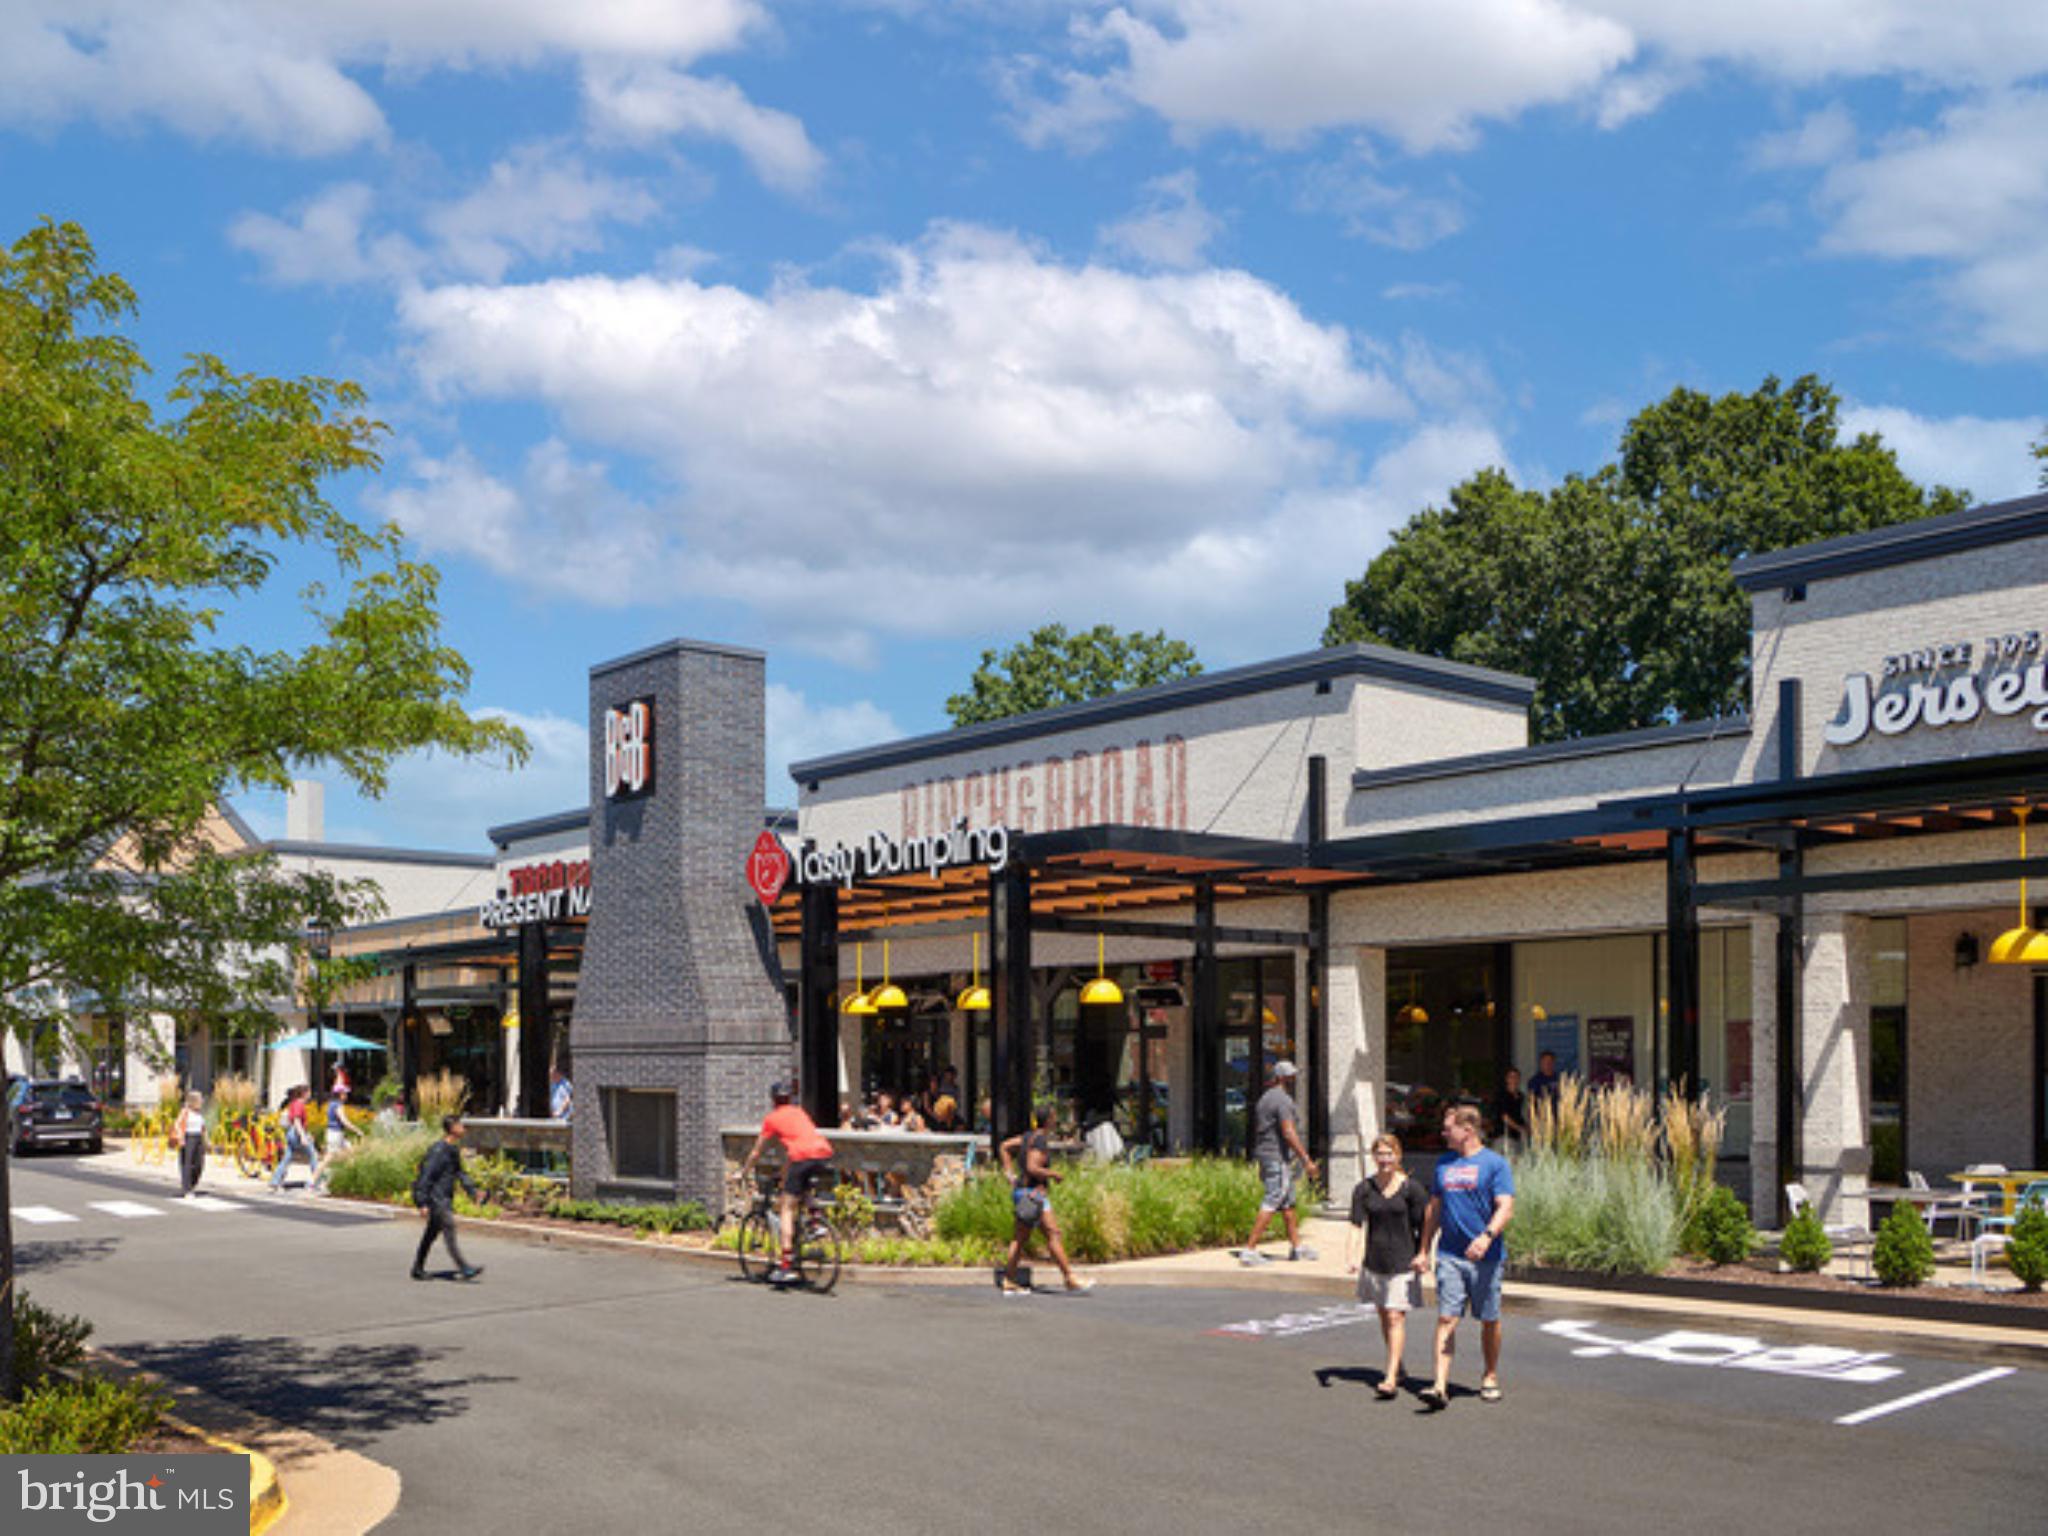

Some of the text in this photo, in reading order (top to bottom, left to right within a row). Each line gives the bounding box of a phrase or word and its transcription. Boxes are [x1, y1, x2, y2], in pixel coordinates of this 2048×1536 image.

[1882, 641, 1973, 676] SINCE
[796, 816, 1009, 889] Tasty Dumpling
[480, 890, 565, 928] PRESENT
